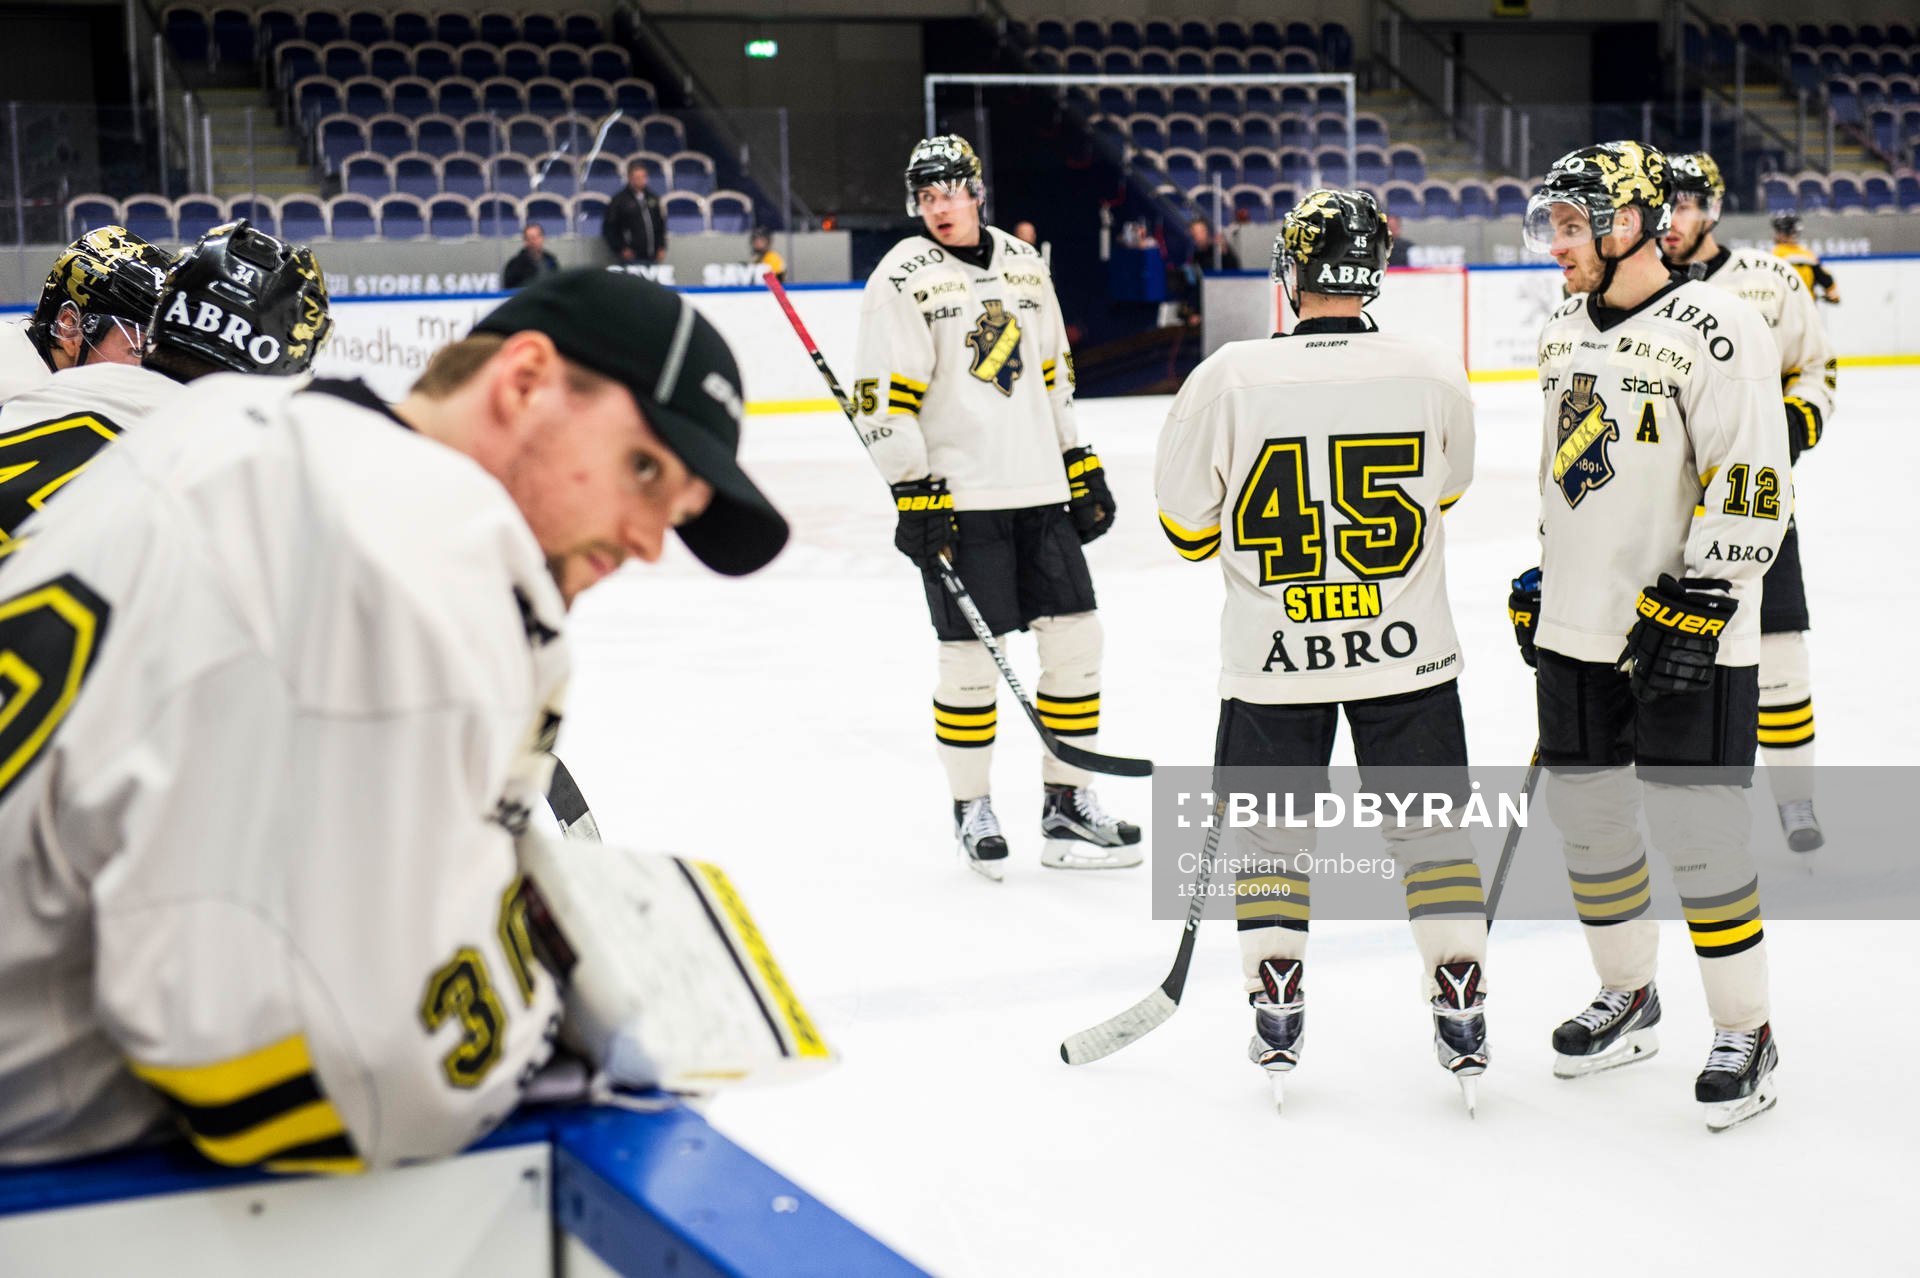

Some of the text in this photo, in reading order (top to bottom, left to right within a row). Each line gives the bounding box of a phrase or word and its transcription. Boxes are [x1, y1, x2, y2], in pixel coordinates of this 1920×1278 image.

[1354, 235, 1368, 249] 45
[232, 264, 255, 285] 34
[354, 273, 422, 295] STORE
[425, 273, 441, 294] &
[444, 271, 500, 294] SAVE
[1317, 263, 1385, 288] ÅBRO
[164, 290, 281, 365] ÅBRO
[1653, 297, 1735, 362] ÅBRO
[1635, 401, 1660, 445] A
[1232, 430, 1426, 586] 45
[1723, 463, 1780, 520] 12
[1704, 540, 1774, 564] ÅBRO
[1284, 582, 1383, 624] STEEN
[1262, 621, 1419, 674] ÅBRO
